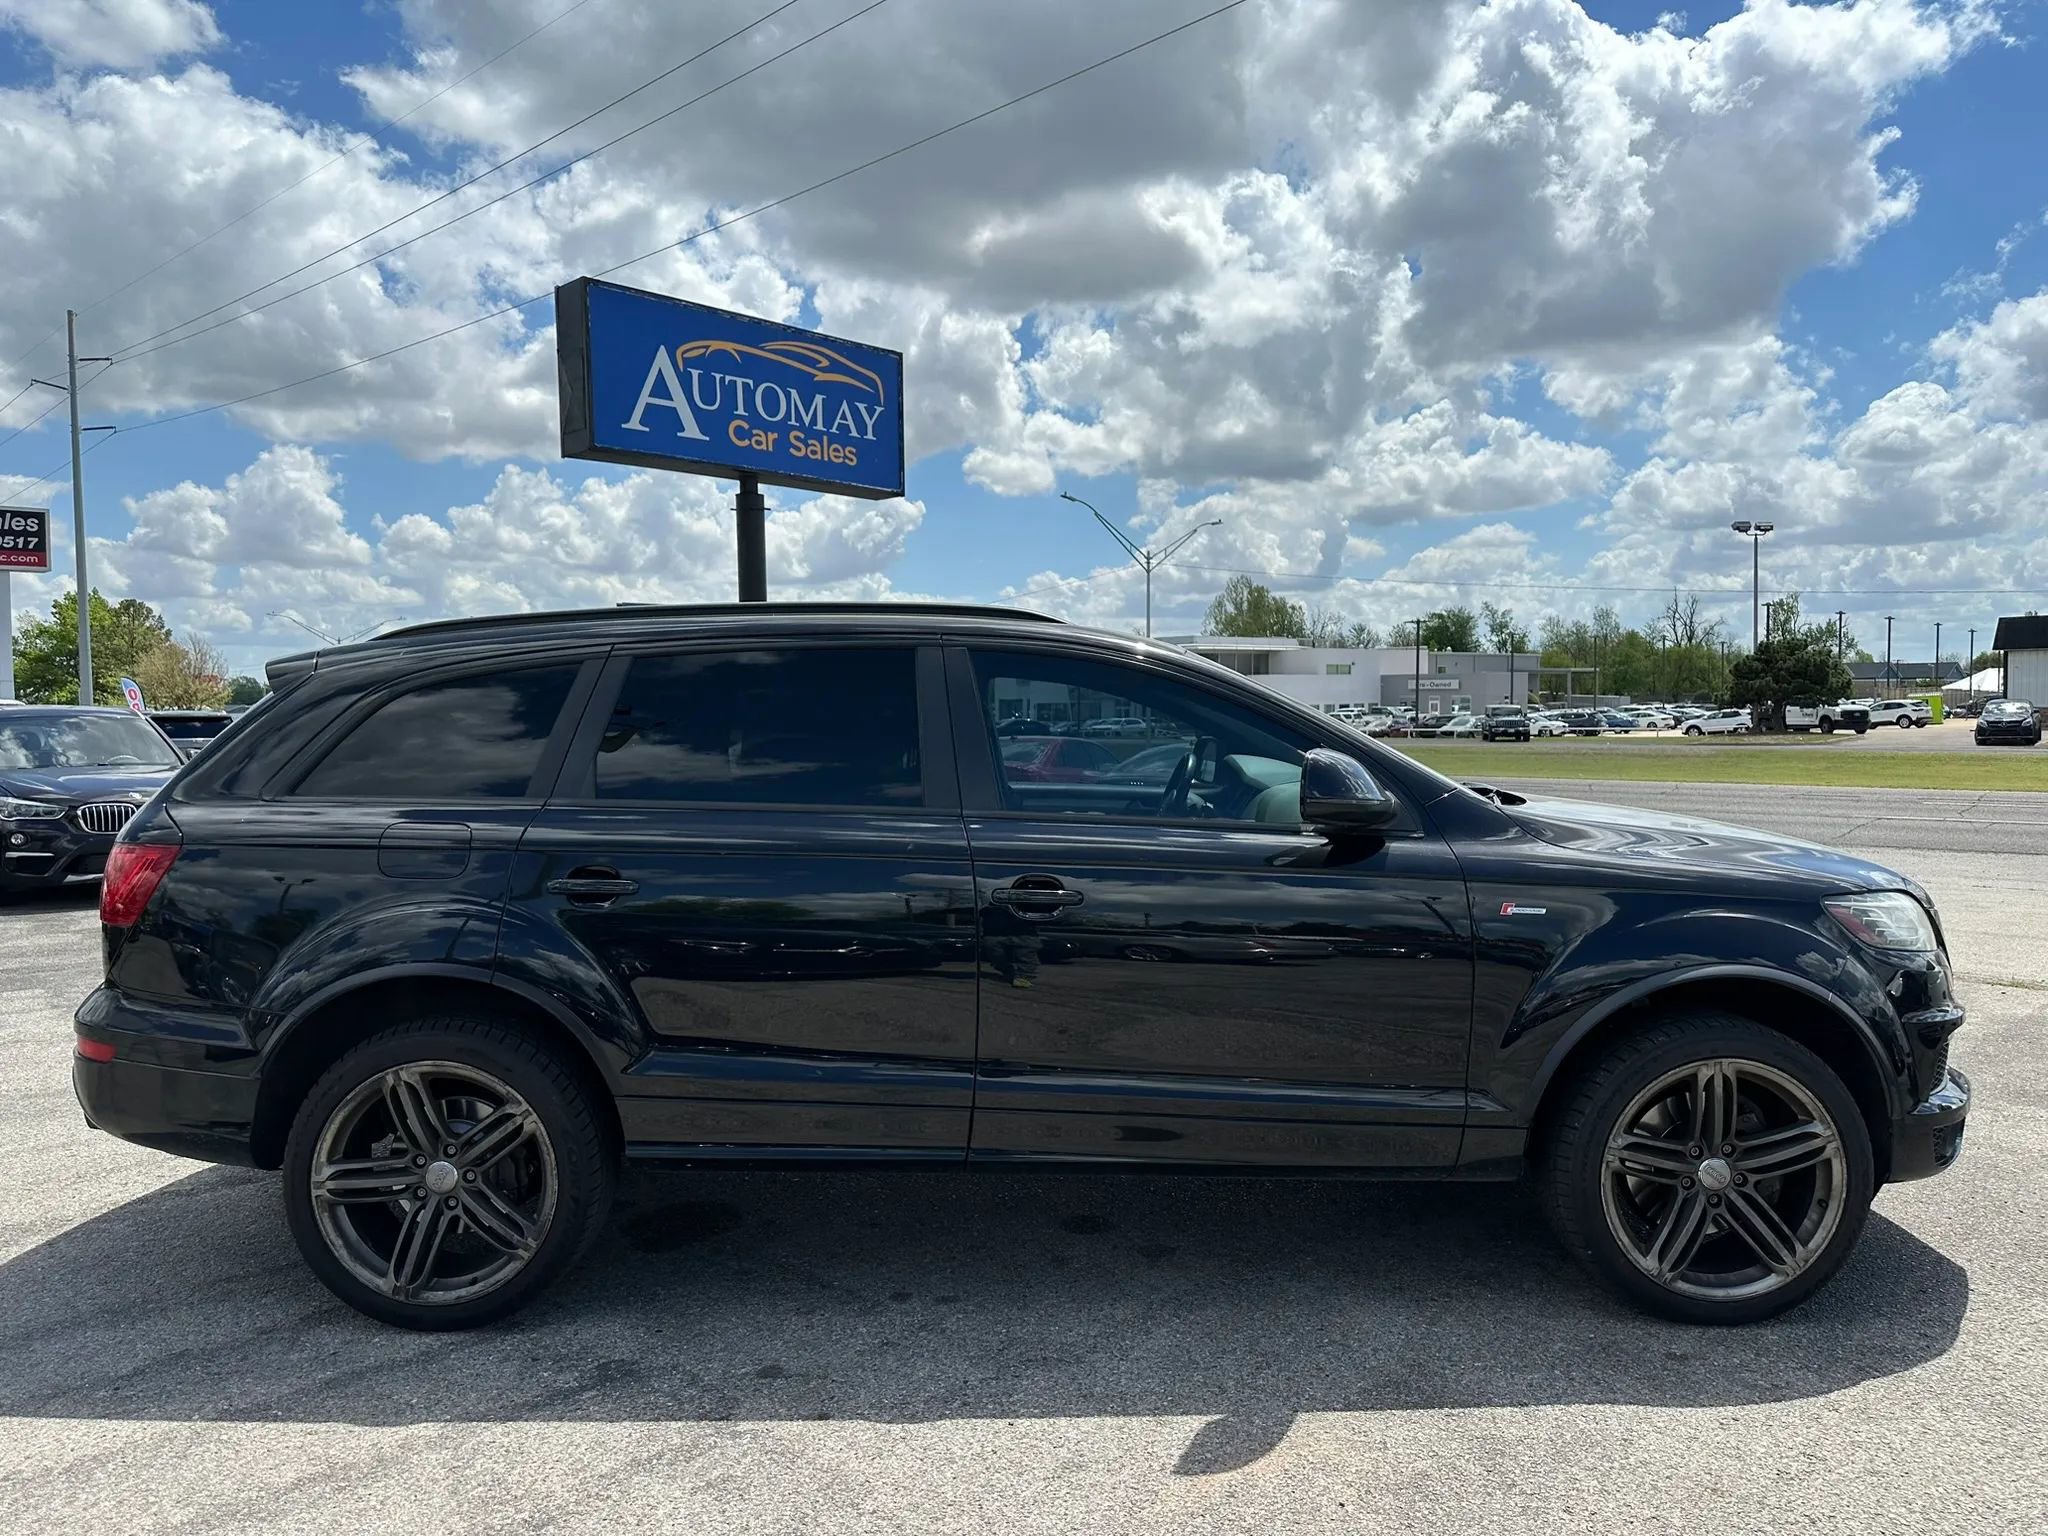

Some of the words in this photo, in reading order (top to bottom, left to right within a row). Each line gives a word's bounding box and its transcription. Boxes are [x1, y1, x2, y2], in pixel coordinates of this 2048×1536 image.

[621, 345, 884, 441] AUTOMAY
[728, 419, 778, 452] Car
[788, 430, 858, 466] Sales
[0, 512, 39, 532] les
[0, 535, 39, 549] 517
[1416, 681, 1452, 689] re-Owned
